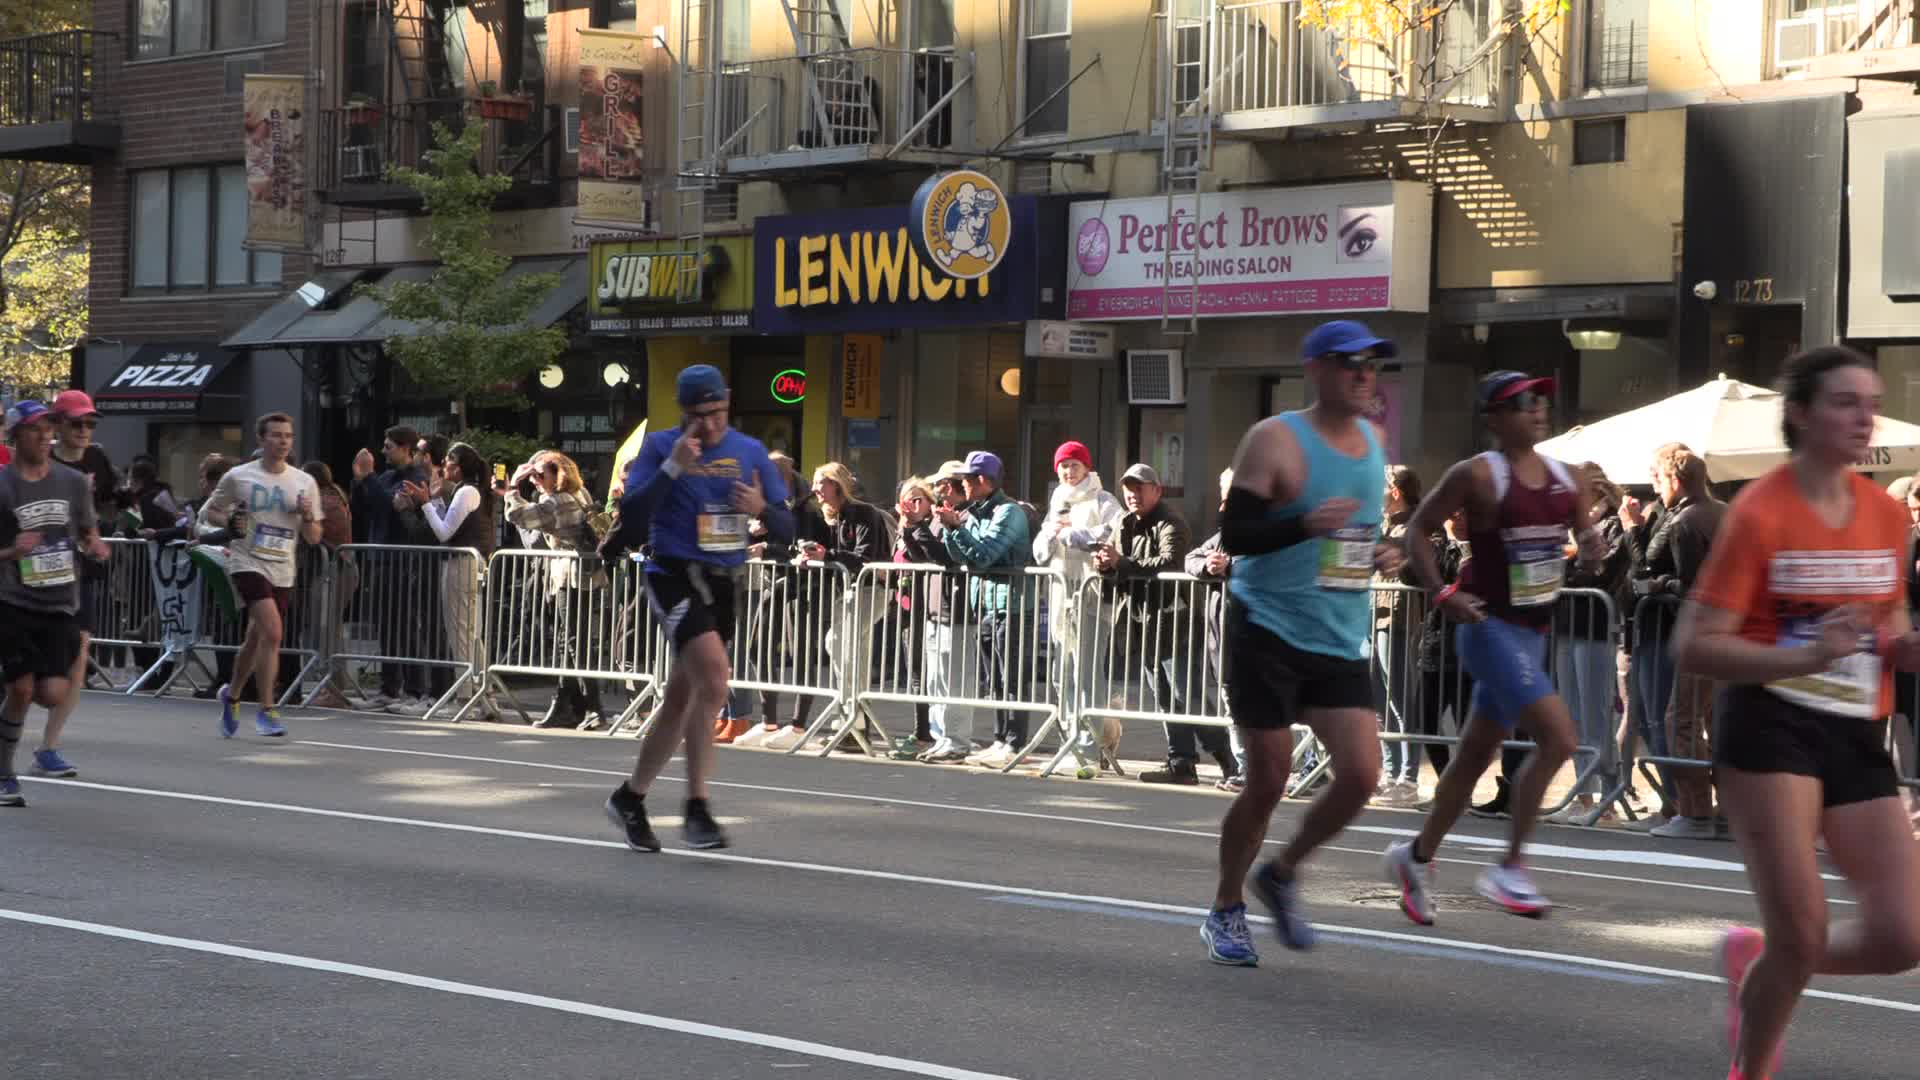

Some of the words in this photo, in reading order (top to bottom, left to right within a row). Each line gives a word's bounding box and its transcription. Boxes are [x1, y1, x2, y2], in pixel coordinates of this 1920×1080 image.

[928, 186, 953, 244] LENWICH
[1117, 208, 1228, 254] Perfect
[1240, 206, 1329, 248] Brows
[774, 226, 990, 308] LENWI
[1143, 258, 1233, 280] THREADING
[1237, 255, 1293, 275] SALON
[1735, 278, 1774, 304] 1273
[110, 364, 213, 388] PIZZA
